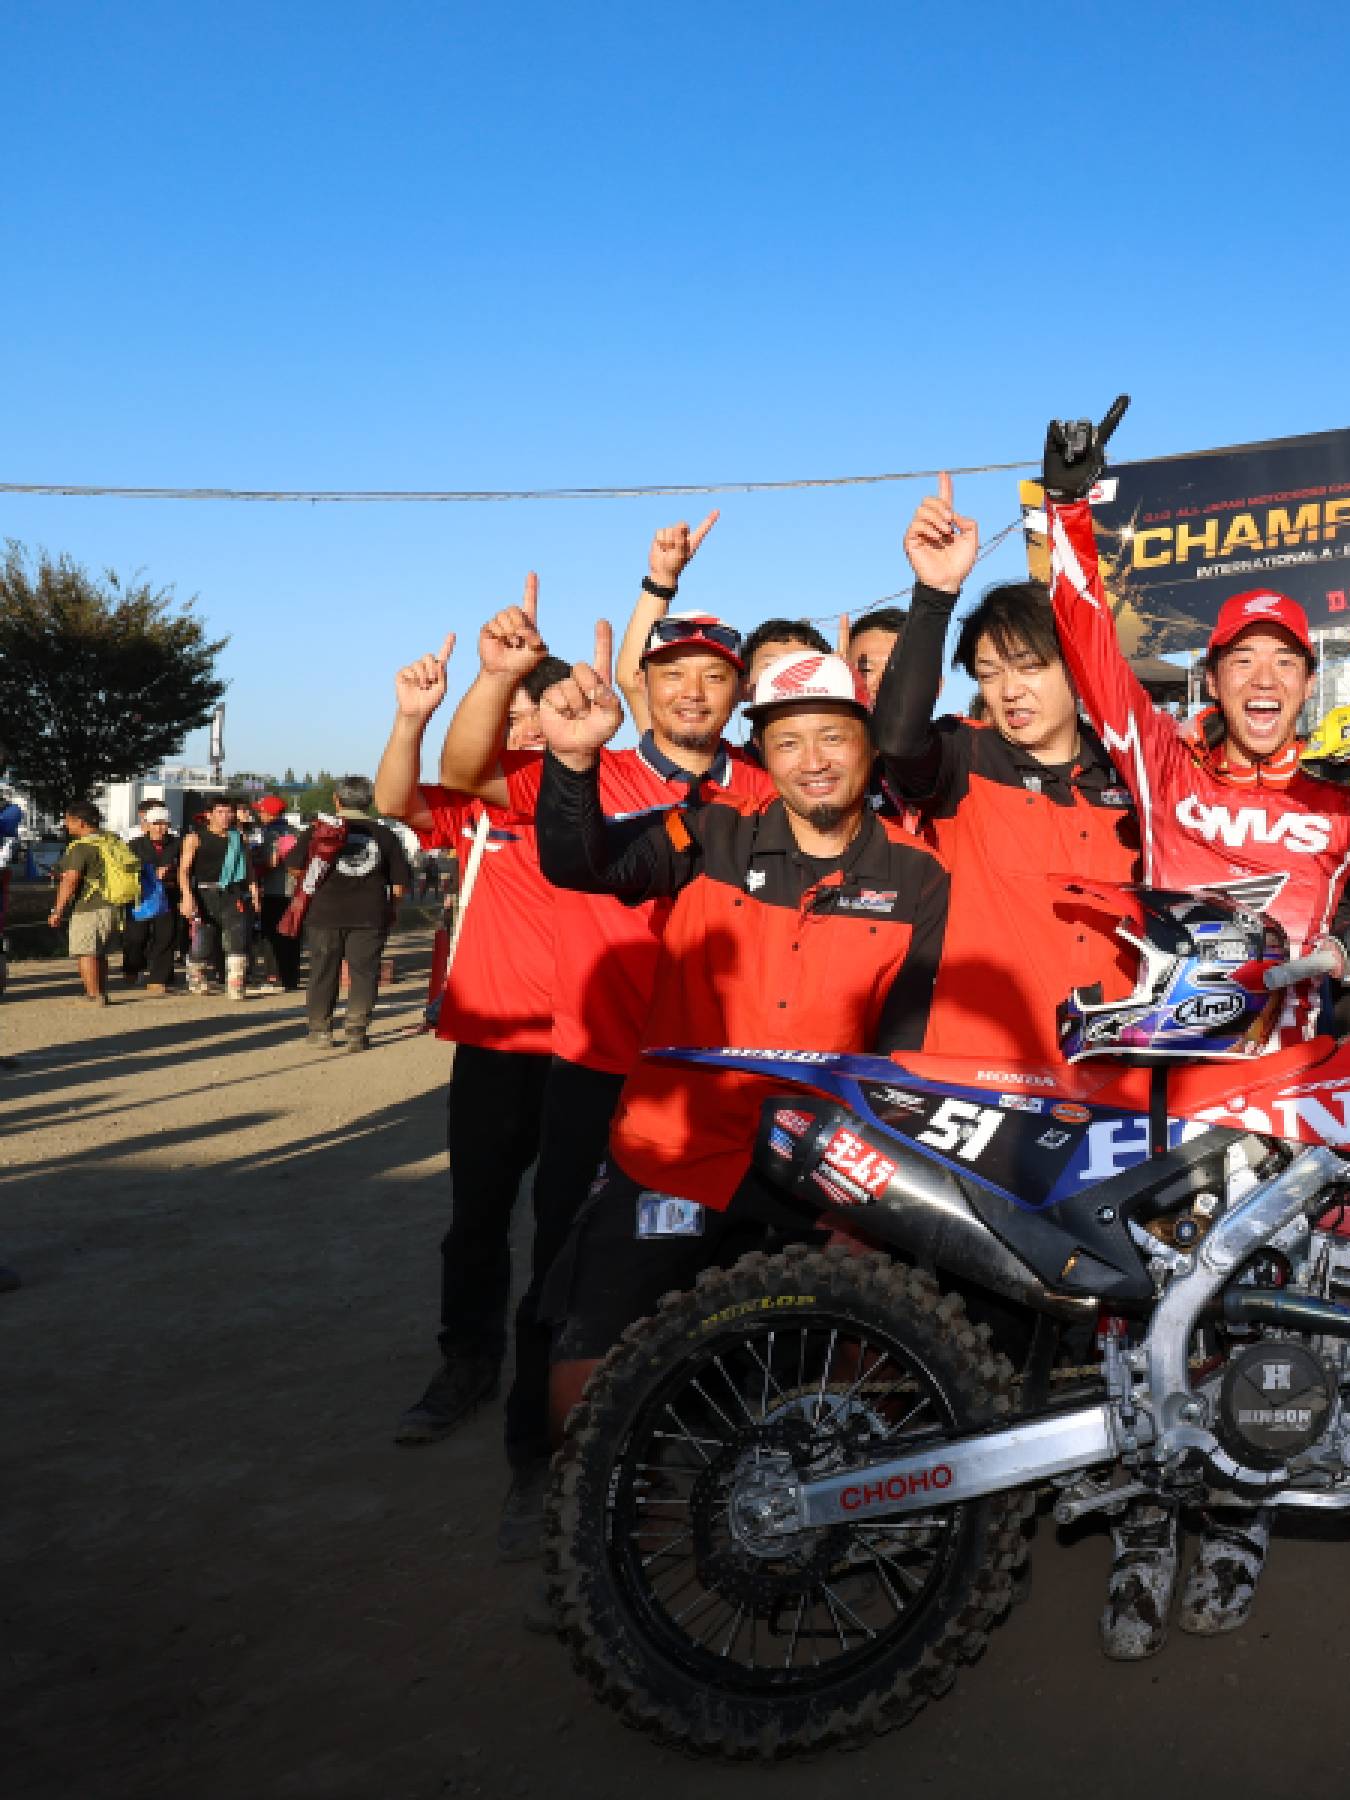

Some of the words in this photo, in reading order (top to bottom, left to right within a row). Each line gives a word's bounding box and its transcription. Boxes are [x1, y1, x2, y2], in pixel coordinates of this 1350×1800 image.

[1196, 552, 1316, 580] INTERNATIONAL
[1178, 992, 1238, 1026] Arai
[975, 1071, 1056, 1088] HONDA
[915, 1097, 1006, 1162] 51
[824, 1131, 896, 1190] ヨシムラ
[839, 1463, 954, 1512] CHOHO
